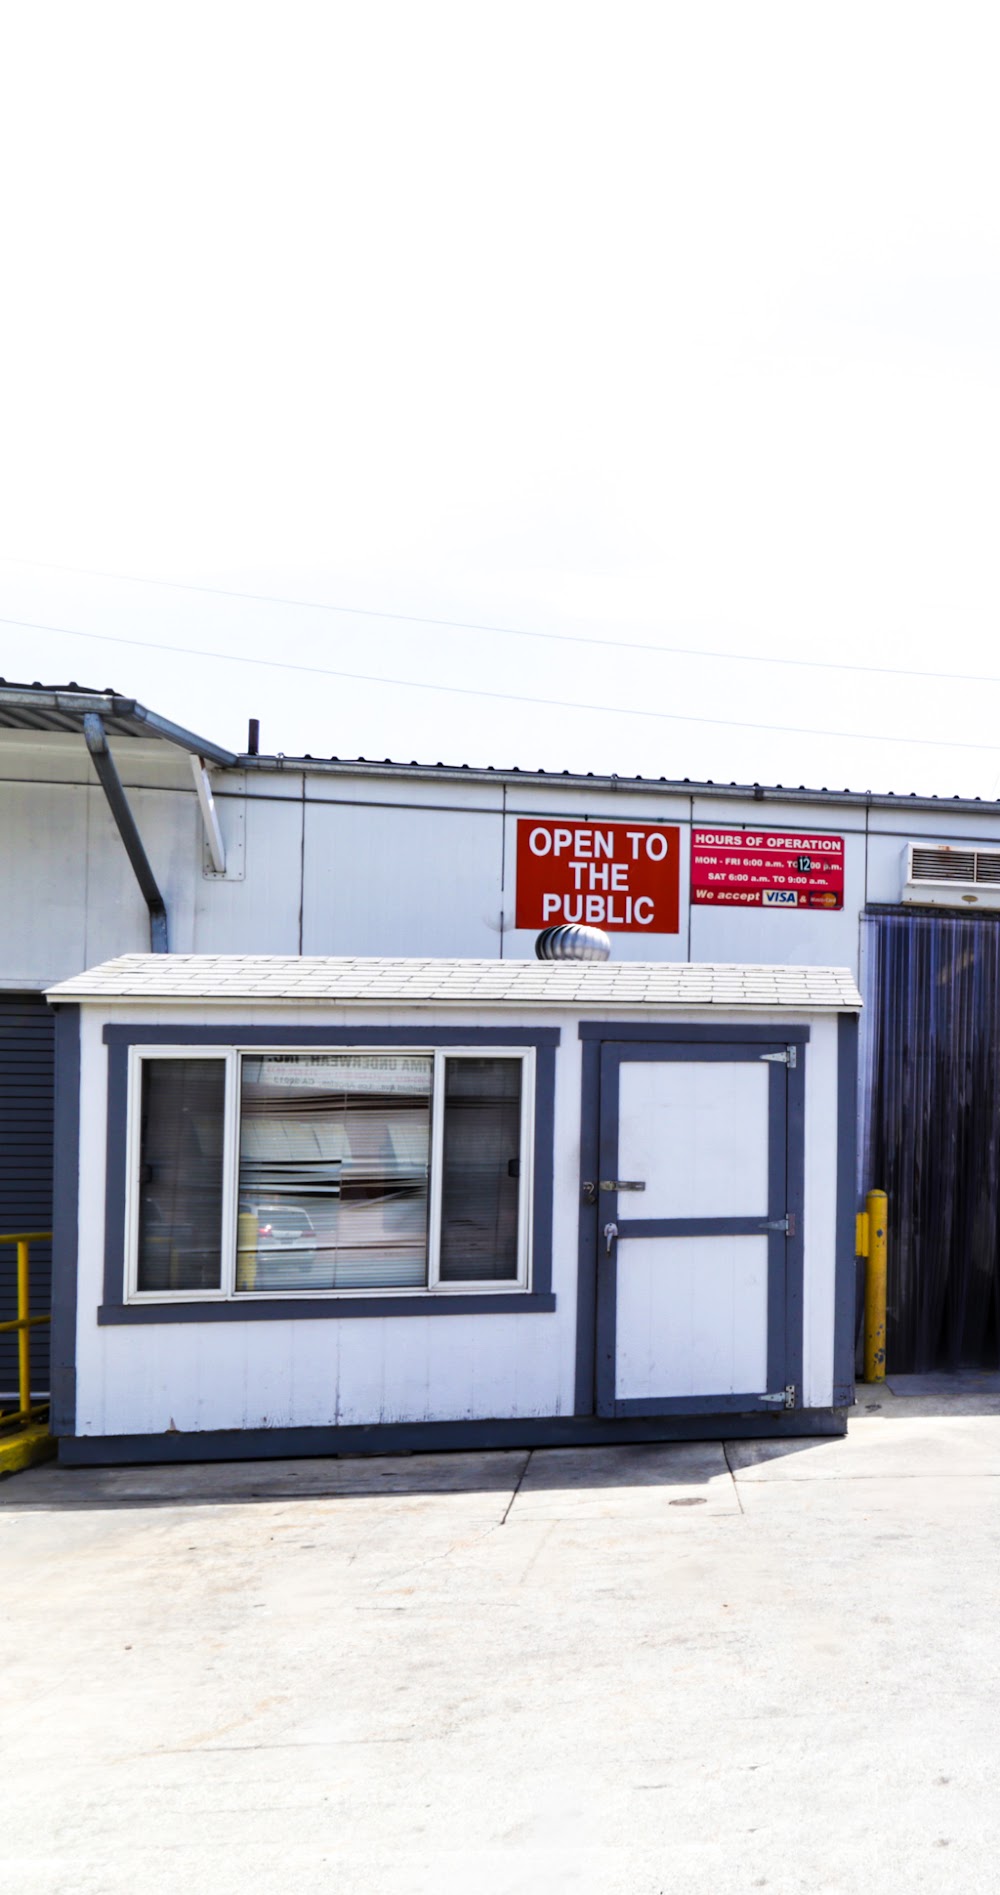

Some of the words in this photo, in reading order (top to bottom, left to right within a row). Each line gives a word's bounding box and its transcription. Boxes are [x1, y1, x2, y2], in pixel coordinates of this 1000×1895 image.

[529, 827, 614, 858] OPEN
[626, 832, 668, 861] TO
[695, 834, 742, 846] HOURS
[746, 836, 763, 847] OF
[766, 837, 841, 850] OPERATION
[695, 856, 717, 865] MON
[725, 857, 741, 865] FRI
[743, 858, 762, 867] 6:00
[765, 860, 784, 868] a.m.
[568, 862, 629, 891] THE
[708, 872, 726, 880] SAT
[728, 873, 748, 882] 6:00
[772, 875, 786, 883] TO
[787, 876, 807, 884] 9:00
[696, 889, 714, 899] We
[717, 891, 760, 902] accept
[766, 892, 796, 903] VISA
[543, 893, 654, 924] PUBLIC
